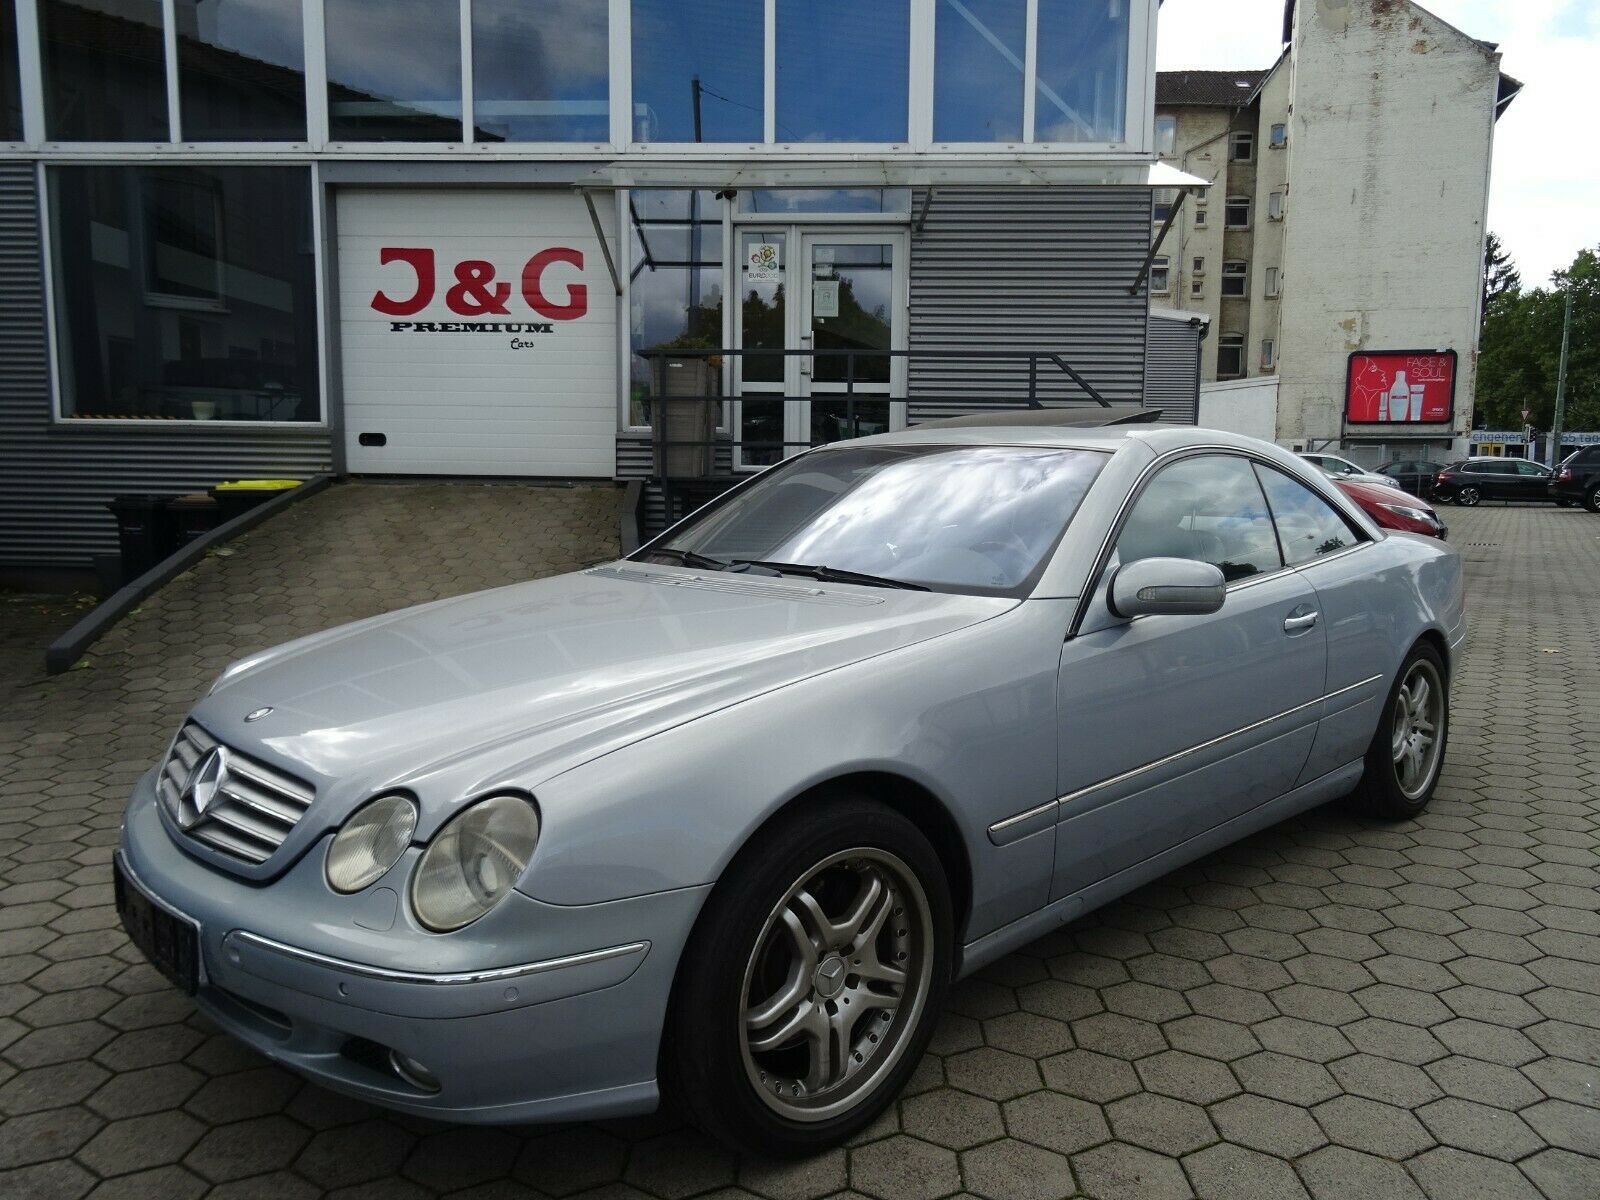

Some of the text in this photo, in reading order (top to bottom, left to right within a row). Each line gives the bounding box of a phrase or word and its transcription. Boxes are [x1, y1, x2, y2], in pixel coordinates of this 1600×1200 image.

[370, 247, 588, 321] J&G
[390, 322, 554, 333] PREMIUM
[510, 338, 535, 350] Cars
[1406, 356, 1447, 368] FACE &
[1411, 367, 1446, 378] SOUL
